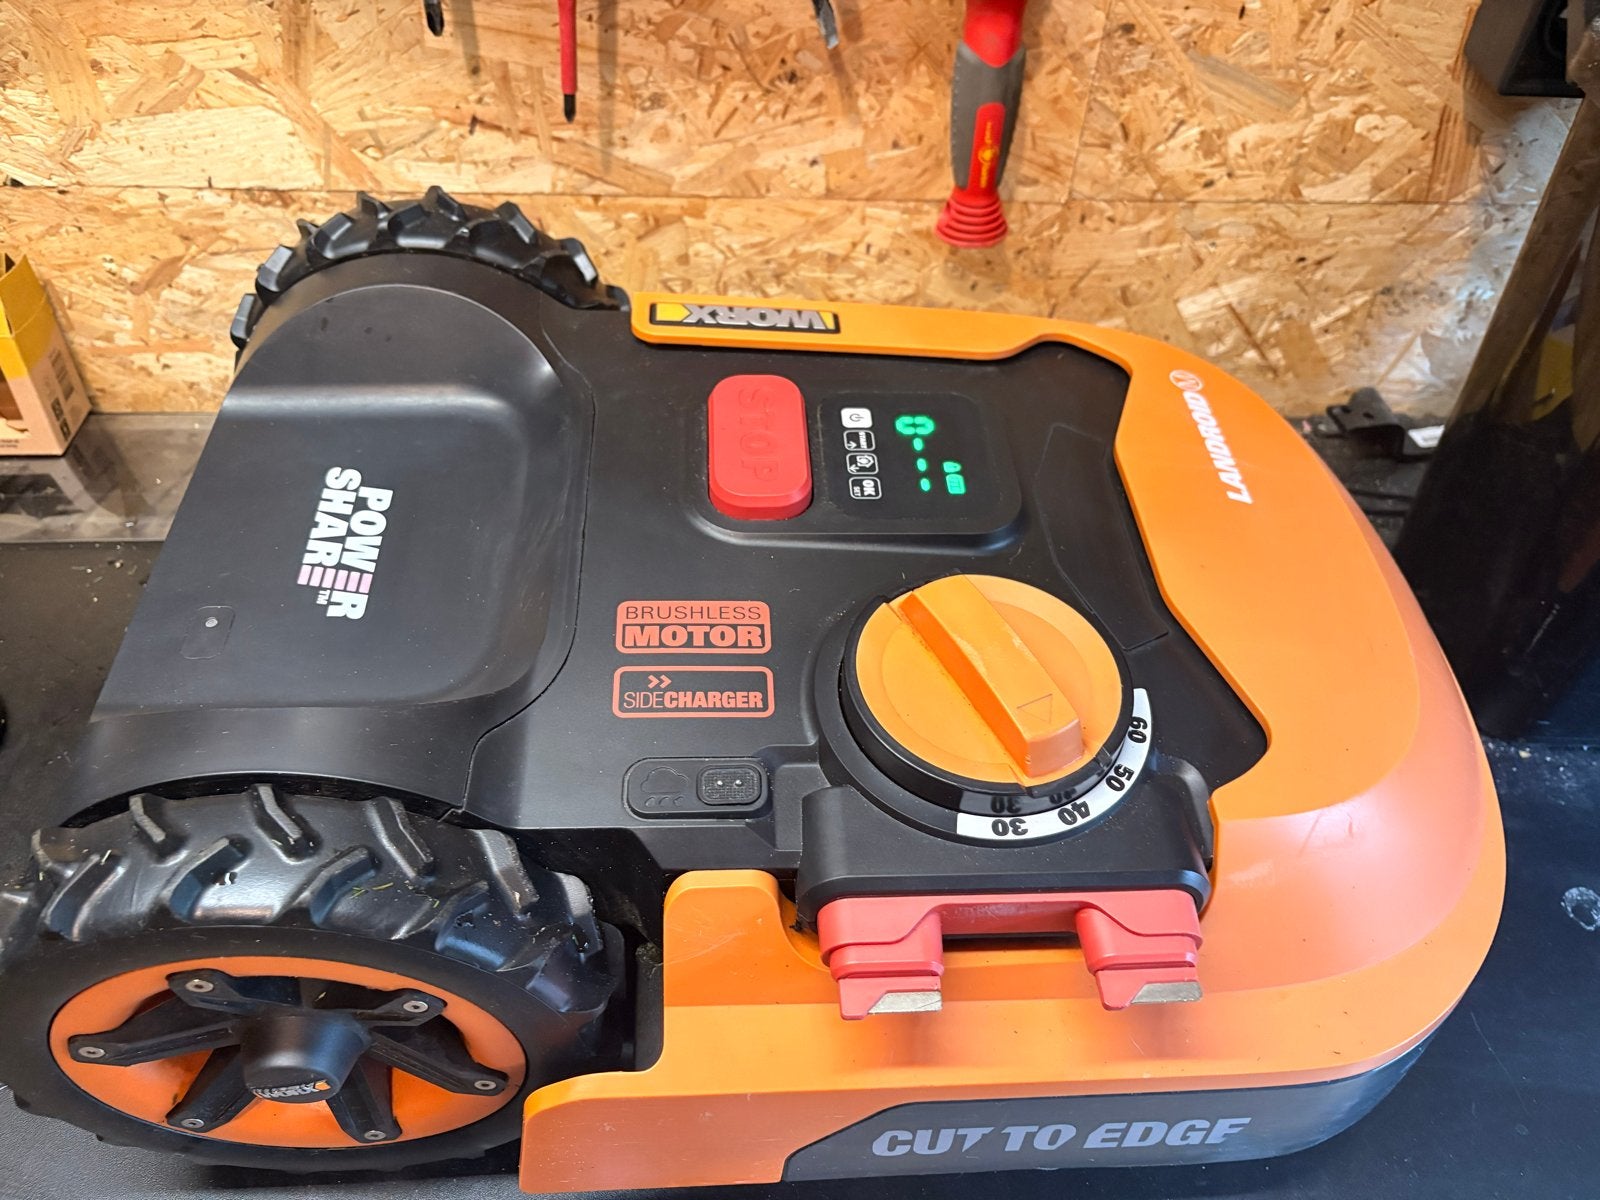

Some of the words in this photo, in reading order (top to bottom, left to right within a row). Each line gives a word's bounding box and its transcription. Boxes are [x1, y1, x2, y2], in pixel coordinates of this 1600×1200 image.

[682, 303, 827, 330] WORX
[738, 387, 780, 482] STOP
[1182, 390, 1253, 504] LANDROID
[862, 479, 876, 496] OK
[297, 466, 362, 588] SHARE
[326, 486, 394, 620] POWER
[625, 605, 762, 620] BRUSHLESS
[623, 624, 764, 647] MOTOR
[623, 691, 764, 709] SIDECHARGER
[1126, 716, 1148, 744] 60
[1105, 763, 1135, 792] 50
[991, 817, 1029, 836] 30
[1057, 800, 1091, 826] 40
[872, 1126, 995, 1157] CUT
[1001, 1123, 1077, 1152] TO
[1083, 1117, 1252, 1149] EDGE
